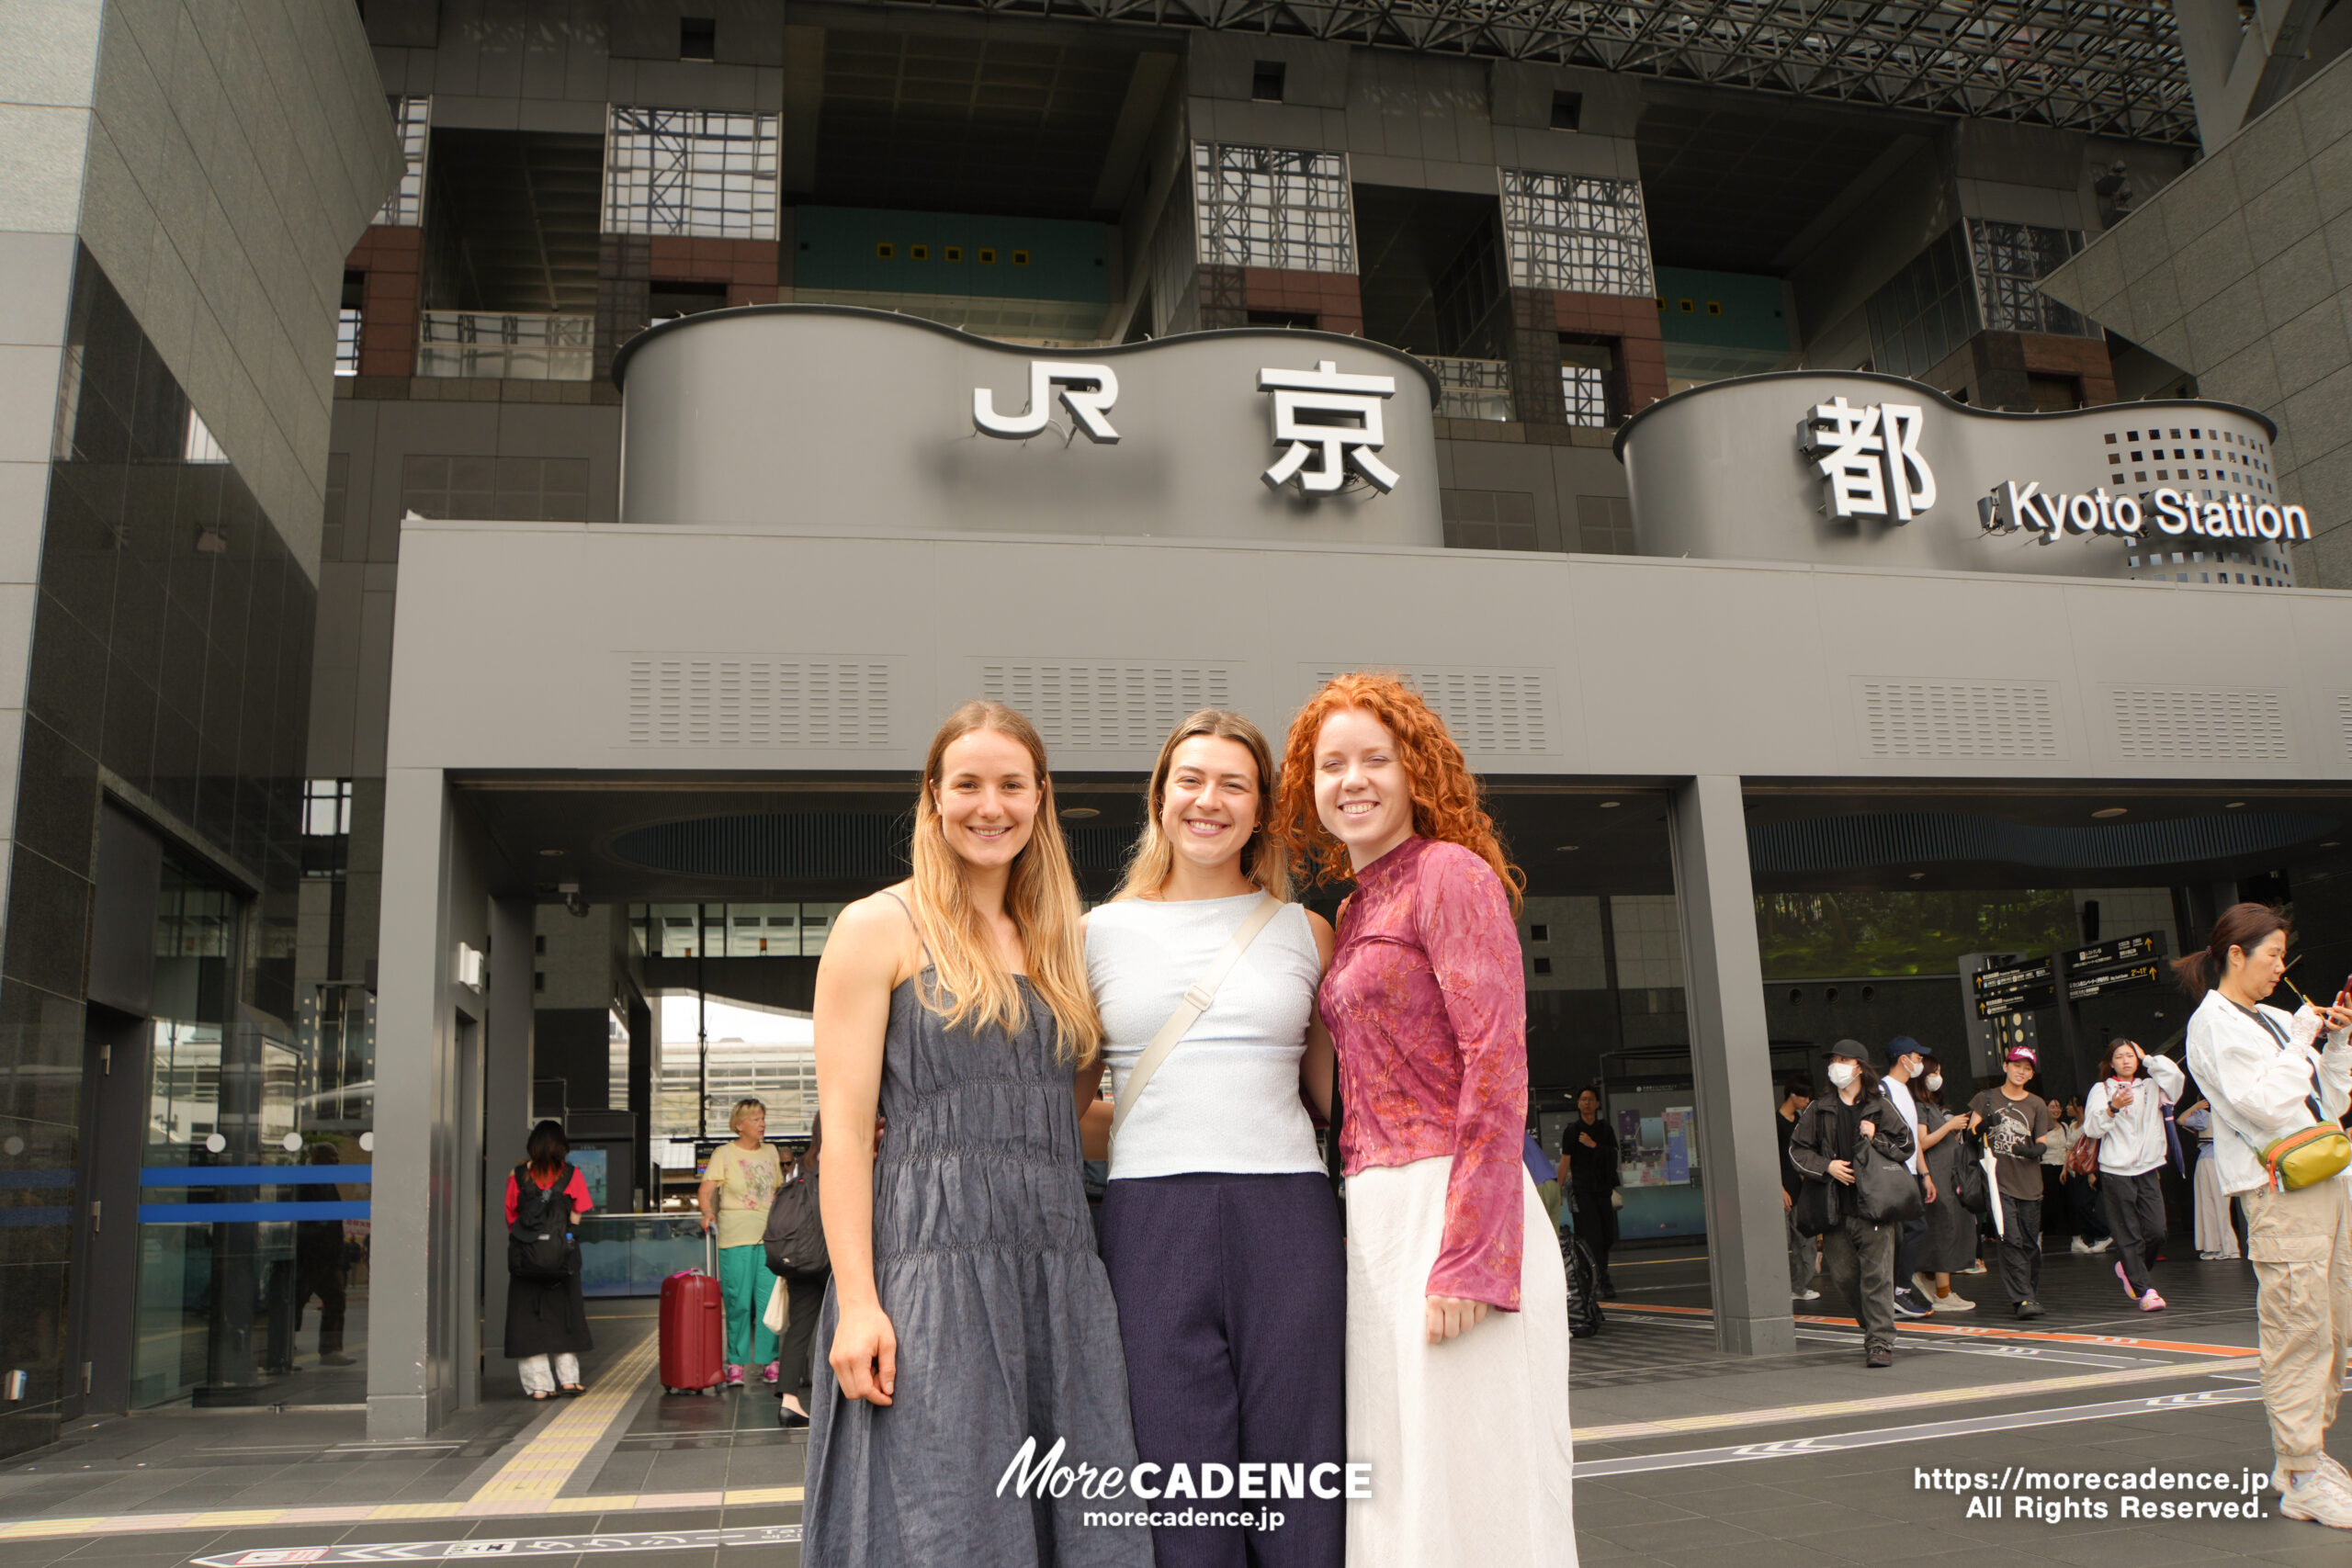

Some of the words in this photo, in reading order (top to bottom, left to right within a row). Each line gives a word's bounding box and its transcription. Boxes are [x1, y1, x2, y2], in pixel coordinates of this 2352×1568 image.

[973, 361, 1121, 445] JR
[2004, 480, 2143, 540] Kyoto
[2155, 488, 2312, 540] Station
